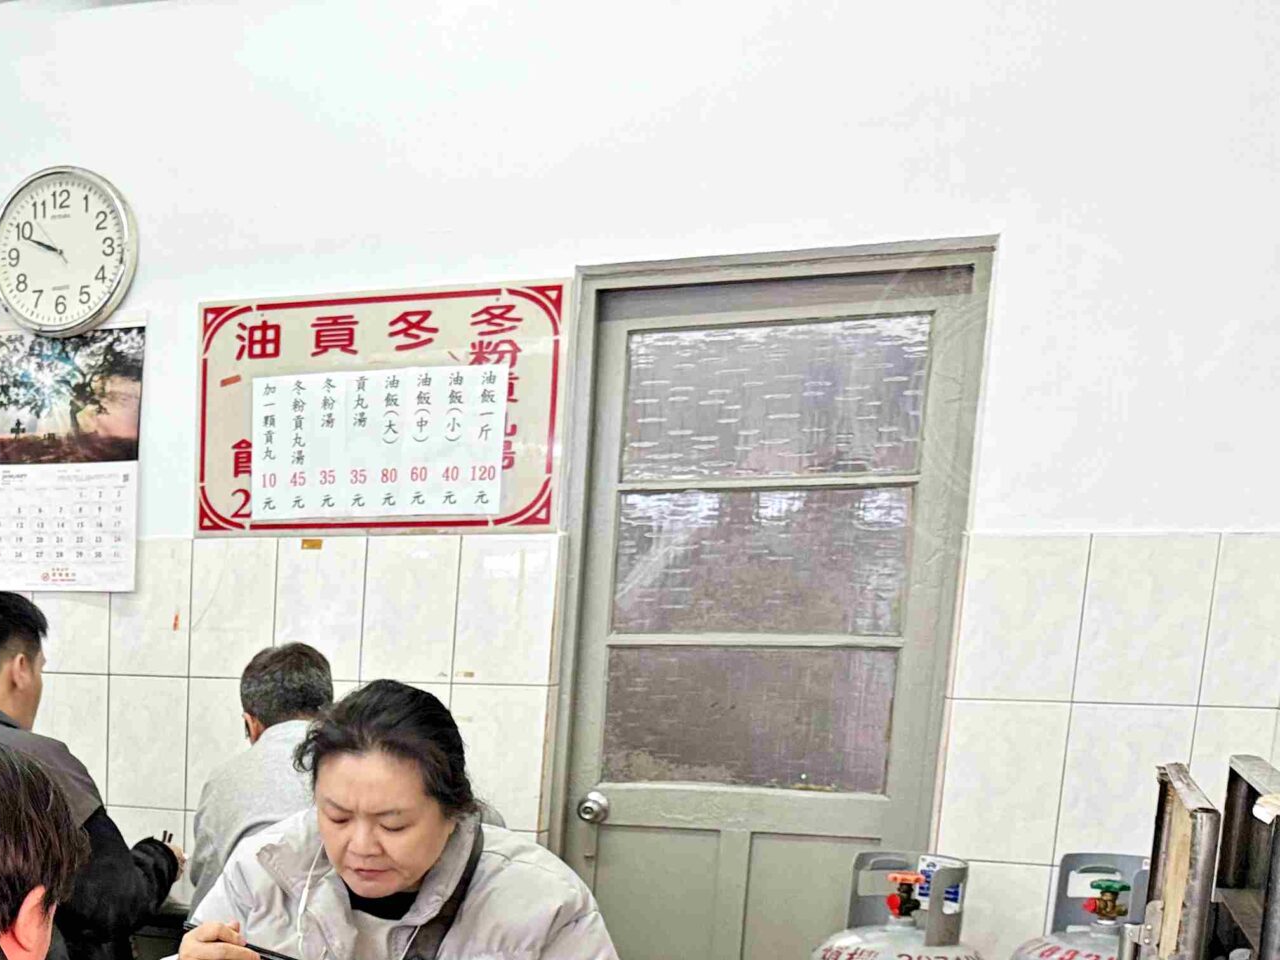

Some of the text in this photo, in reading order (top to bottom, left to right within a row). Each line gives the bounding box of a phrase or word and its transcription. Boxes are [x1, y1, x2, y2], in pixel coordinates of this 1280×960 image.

[51, 190, 70, 209] 12
[83, 194, 89, 212] 1
[32, 200, 46, 219] 11
[96, 211, 107, 230] 2
[16, 221, 33, 241] 10
[102, 237, 115, 256] 3
[8, 248, 20, 267] 9
[16, 274, 27, 292] 8
[95, 265, 107, 283] 4
[32, 290, 43, 308] 7
[79, 285, 91, 304] 5
[55, 295, 66, 314] 6
[262, 473, 277, 488] 10
[290, 471, 306, 487] 45
[320, 470, 336, 485] 35
[350, 469, 367, 484] 35
[381, 467, 397, 483] 80
[410, 466, 427, 481] 60
[442, 466, 459, 481] 40
[471, 465, 496, 481] 120
